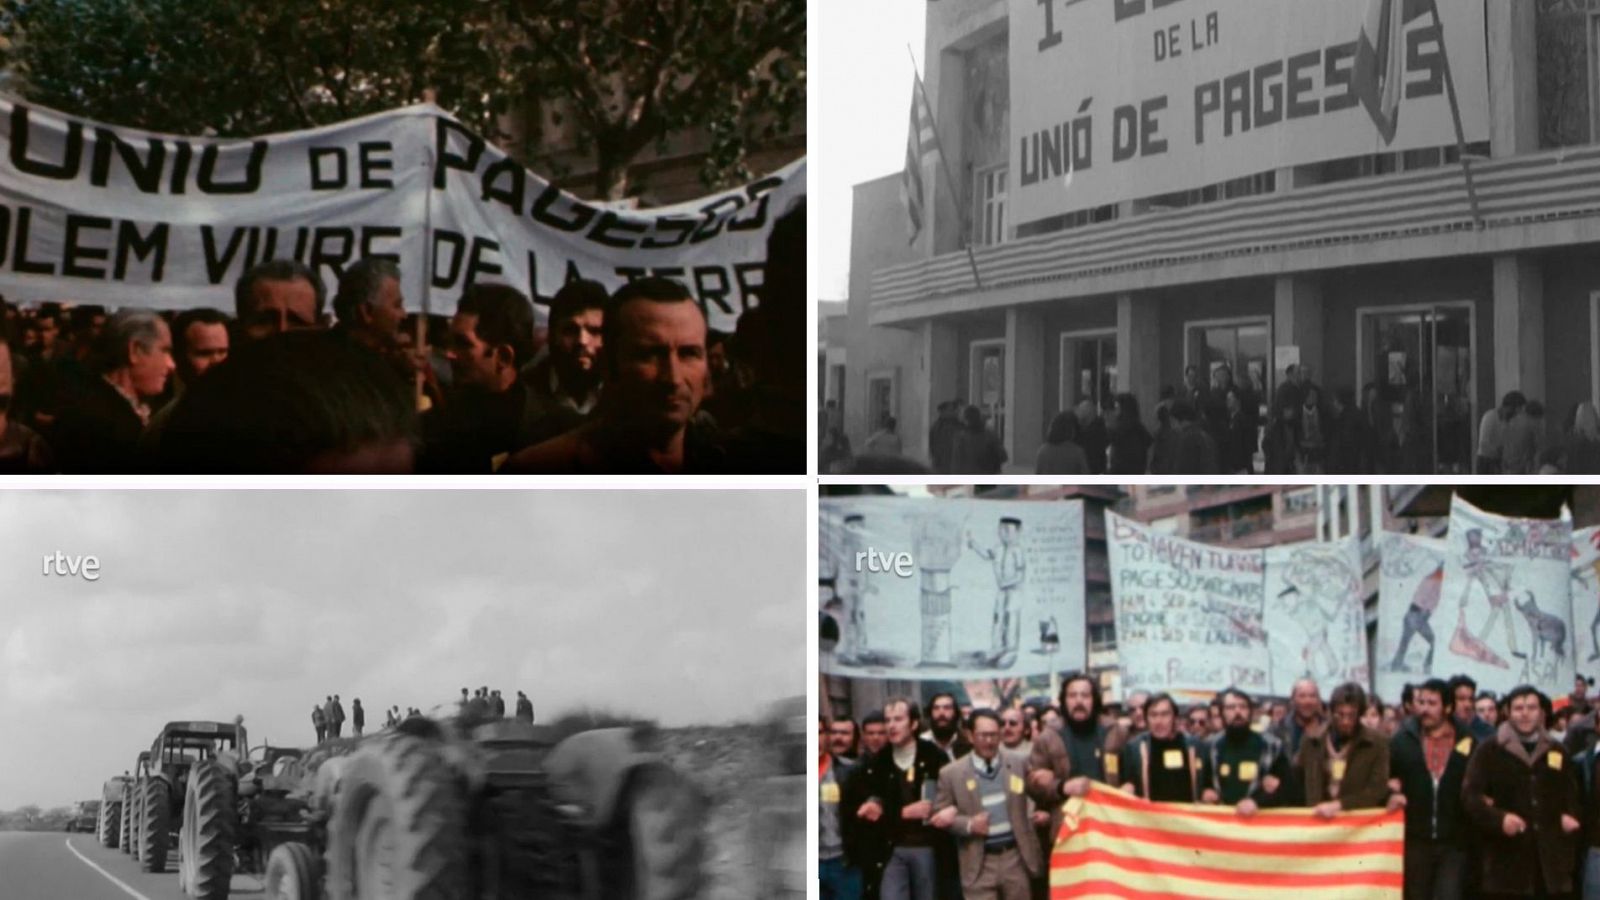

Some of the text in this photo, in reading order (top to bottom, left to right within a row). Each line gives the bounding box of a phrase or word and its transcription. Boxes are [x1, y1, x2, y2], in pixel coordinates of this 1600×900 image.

[1154, 24, 1182, 62] DE
[1191, 11, 1219, 51] LA
[1020, 23, 1443, 187] UNIÓ DE PAGESS
[308, 141, 394, 190] DE
[434, 116, 784, 249] PAGESOS
